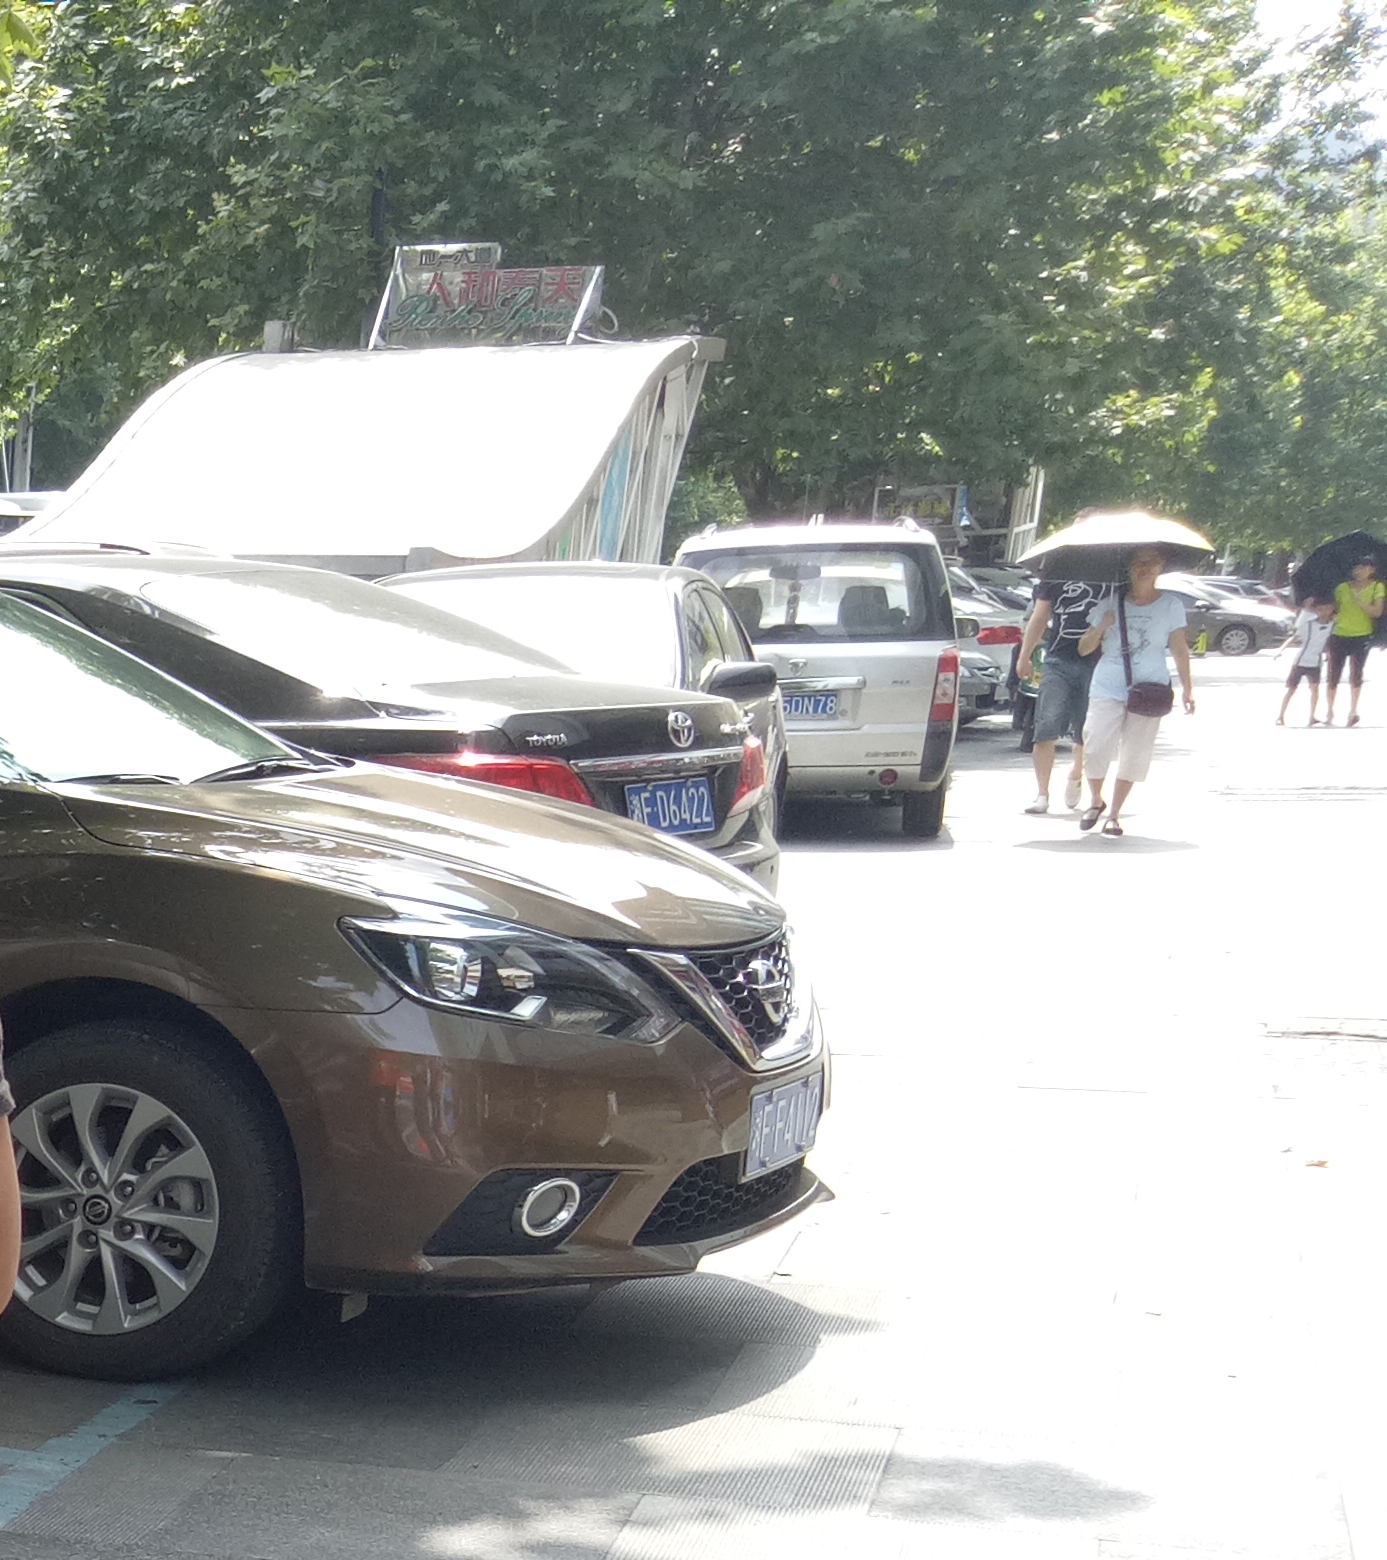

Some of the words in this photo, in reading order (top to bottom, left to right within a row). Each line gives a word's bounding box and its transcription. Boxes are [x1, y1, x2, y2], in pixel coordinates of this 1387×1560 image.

[427, 267, 584, 312] 人和春天
[526, 733, 568, 747] TOYOTA
